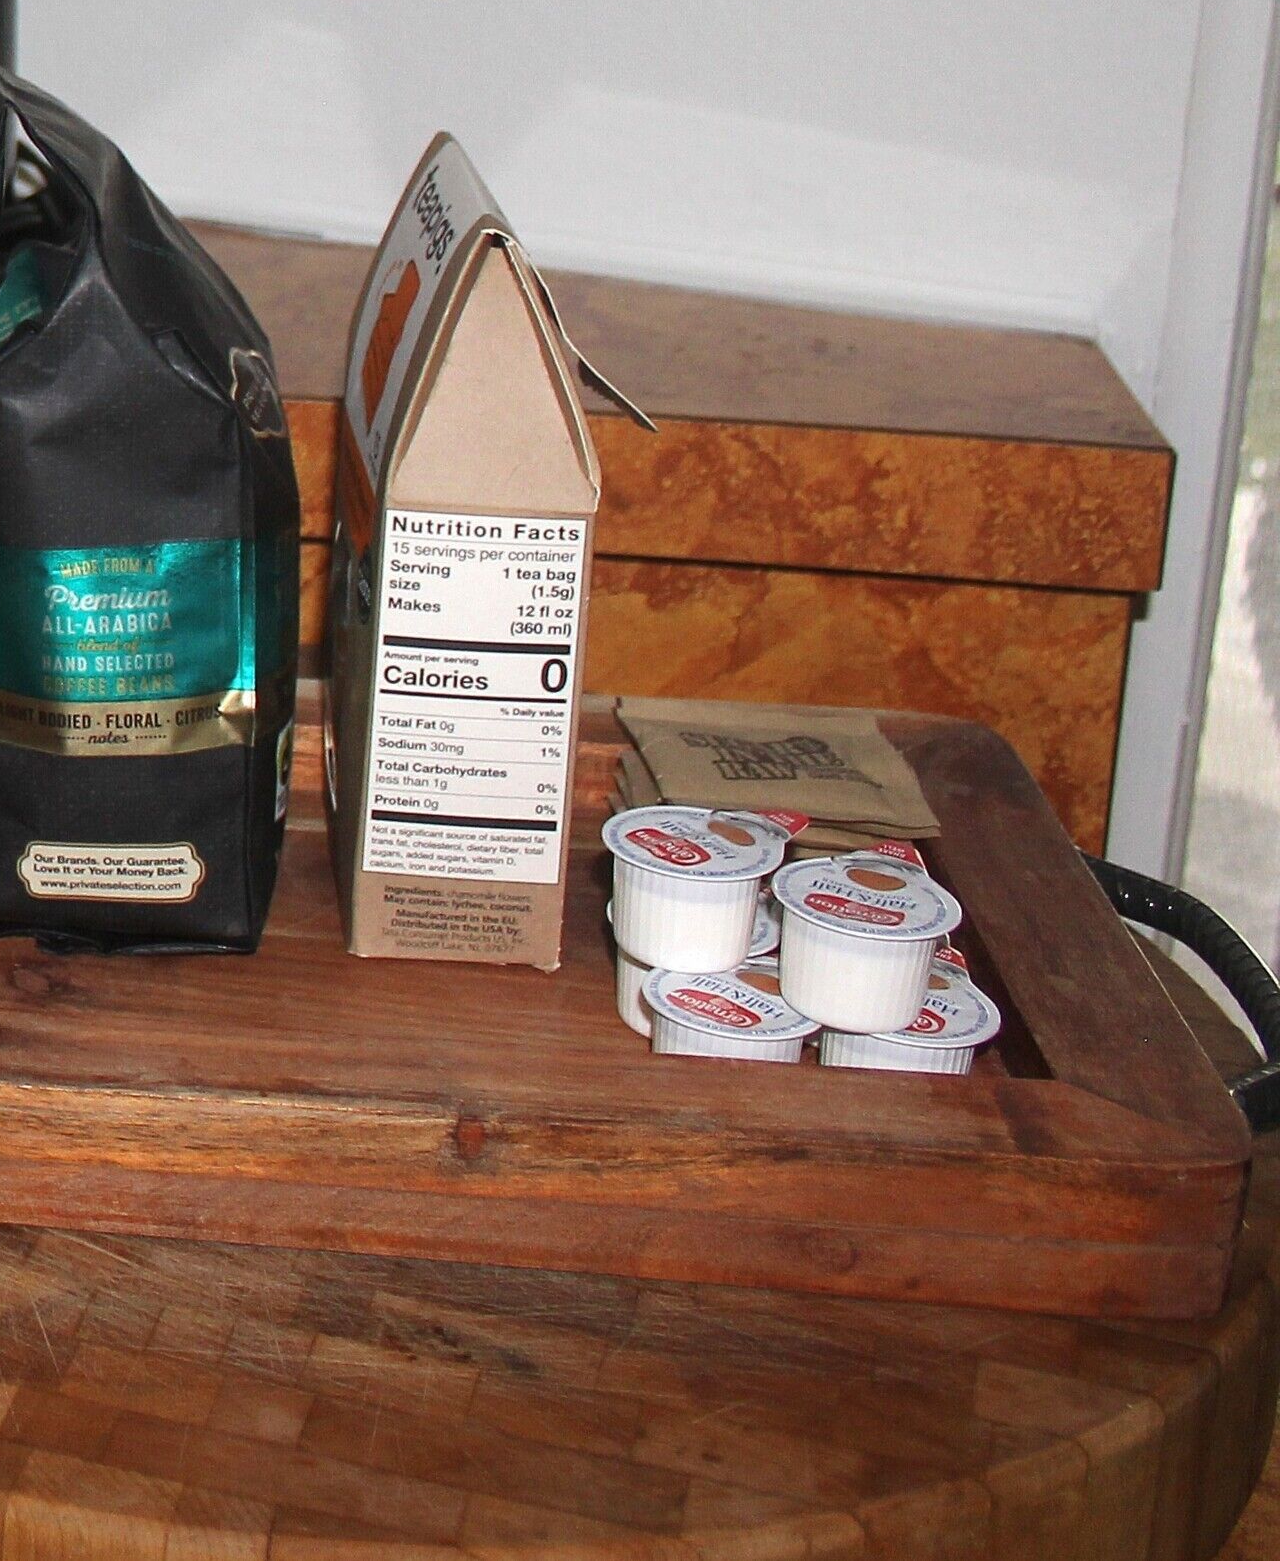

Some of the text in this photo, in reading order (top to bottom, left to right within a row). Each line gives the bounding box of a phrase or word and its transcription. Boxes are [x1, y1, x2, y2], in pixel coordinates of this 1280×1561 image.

[392, 516, 580, 541] Nutrition Facts
[392, 541, 576, 564] 15 servings per container
[60, 560, 98, 578] MADE
[104, 557, 140, 573] FROM
[390, 559, 576, 583] Serving 1 tea bag
[44, 585, 171, 611] Premium
[390, 577, 575, 601] size (1.5g)
[388, 597, 574, 619] Makes 12 fl oz
[42, 612, 172, 635] ALL-ARABICA
[510, 621, 572, 637] (360 ml)
[42, 653, 174, 671] HAND SELECTED
[384, 651, 479, 667] Amount per serving
[384, 658, 568, 693] Calories 0
[40, 710, 91, 729] BODIED
[106, 712, 162, 729] FLORAL
[512, 708, 536, 718] Daily
[539, 709, 564, 717] value
[380, 716, 562, 736] Total Fat 0g 0%
[88, 733, 130, 745] notes
[378, 737, 560, 758] Sodium 30mg 1%
[377, 759, 508, 779] Total Carbohydrates
[375, 774, 558, 793] less than 1g 0%
[374, 795, 556, 815] Protein 0g 0%
[372, 825, 388, 835] Not
[398, 828, 443, 839] significant
[478, 832, 488, 841] of
[406, 851, 434, 860] added
[472, 855, 504, 865] vitamin
[467, 843, 497, 853] dietary
[524, 845, 544, 855] total
[34, 853, 188, 867] Our Brands. Our Guarantee.
[409, 863, 426, 871] iron
[428, 865, 445, 873] and
[34, 864, 188, 877] Love It or Your Money Back.
[40, 880, 182, 891] www.privateselection.com
[690, 976, 730, 994] Half
[670, 991, 752, 1027] Carnation
[745, 995, 784, 1019] Half
